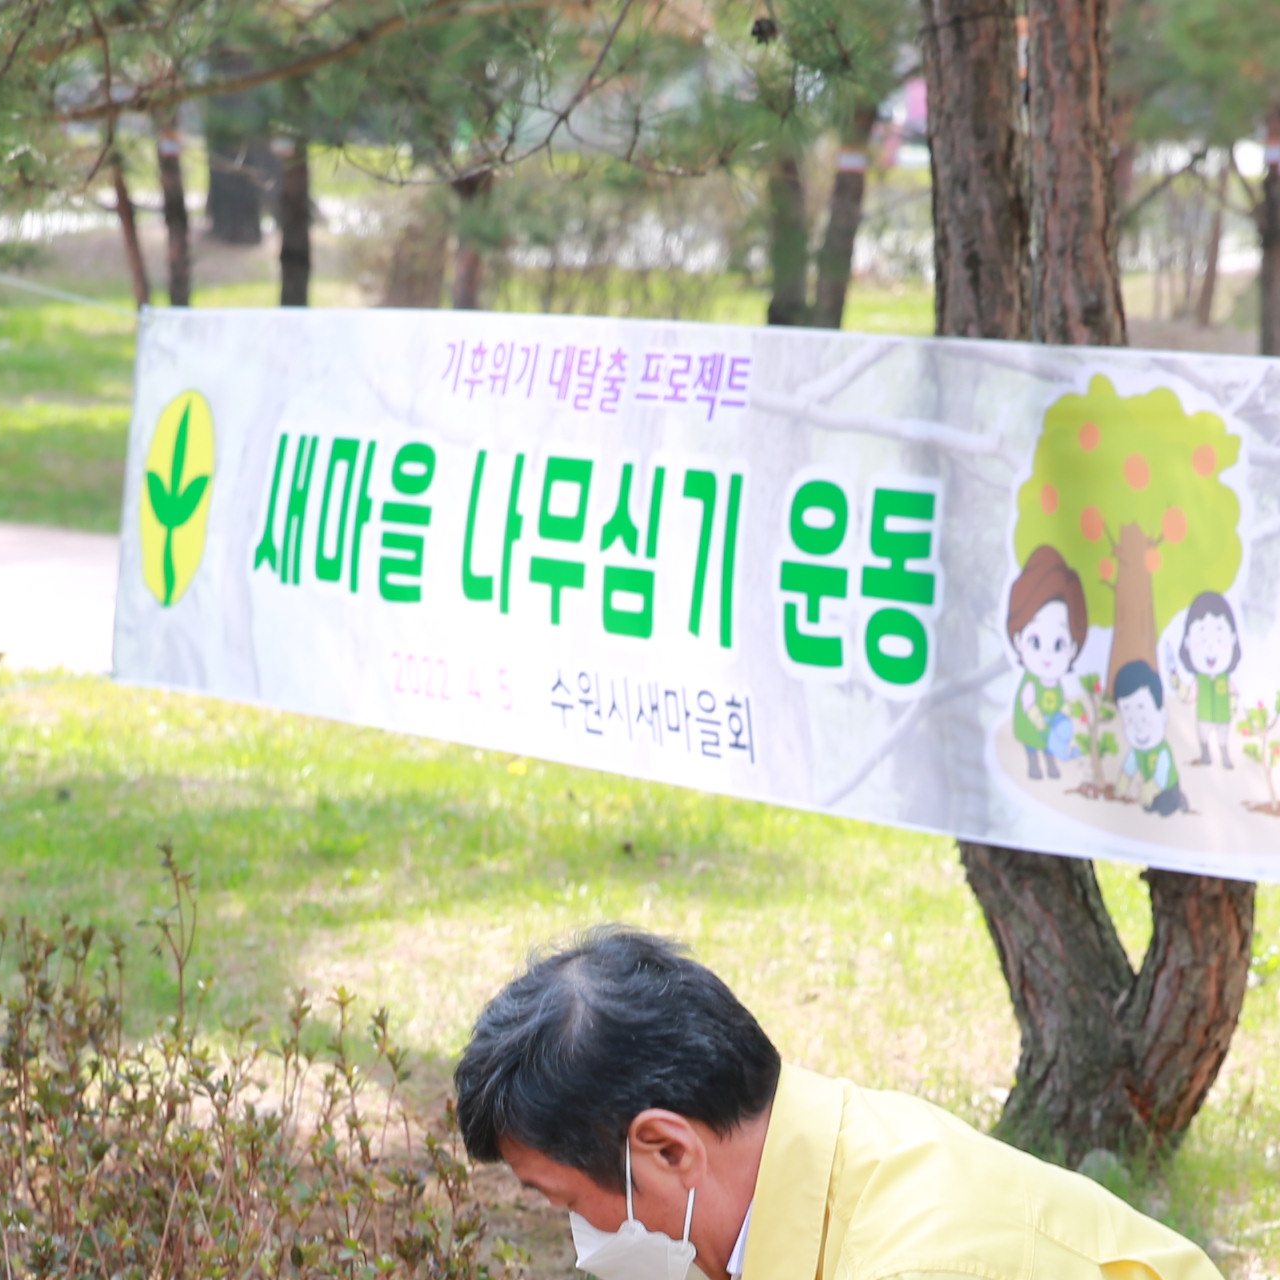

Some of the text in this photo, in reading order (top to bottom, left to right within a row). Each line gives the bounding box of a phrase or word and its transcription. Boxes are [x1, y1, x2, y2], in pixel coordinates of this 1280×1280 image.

[441, 340, 751, 422] 기후위기 대탈출 프로젝트
[253, 433, 937, 686] 새마을 나무심기 운동
[551, 669, 755, 764] 수원시새마을회
